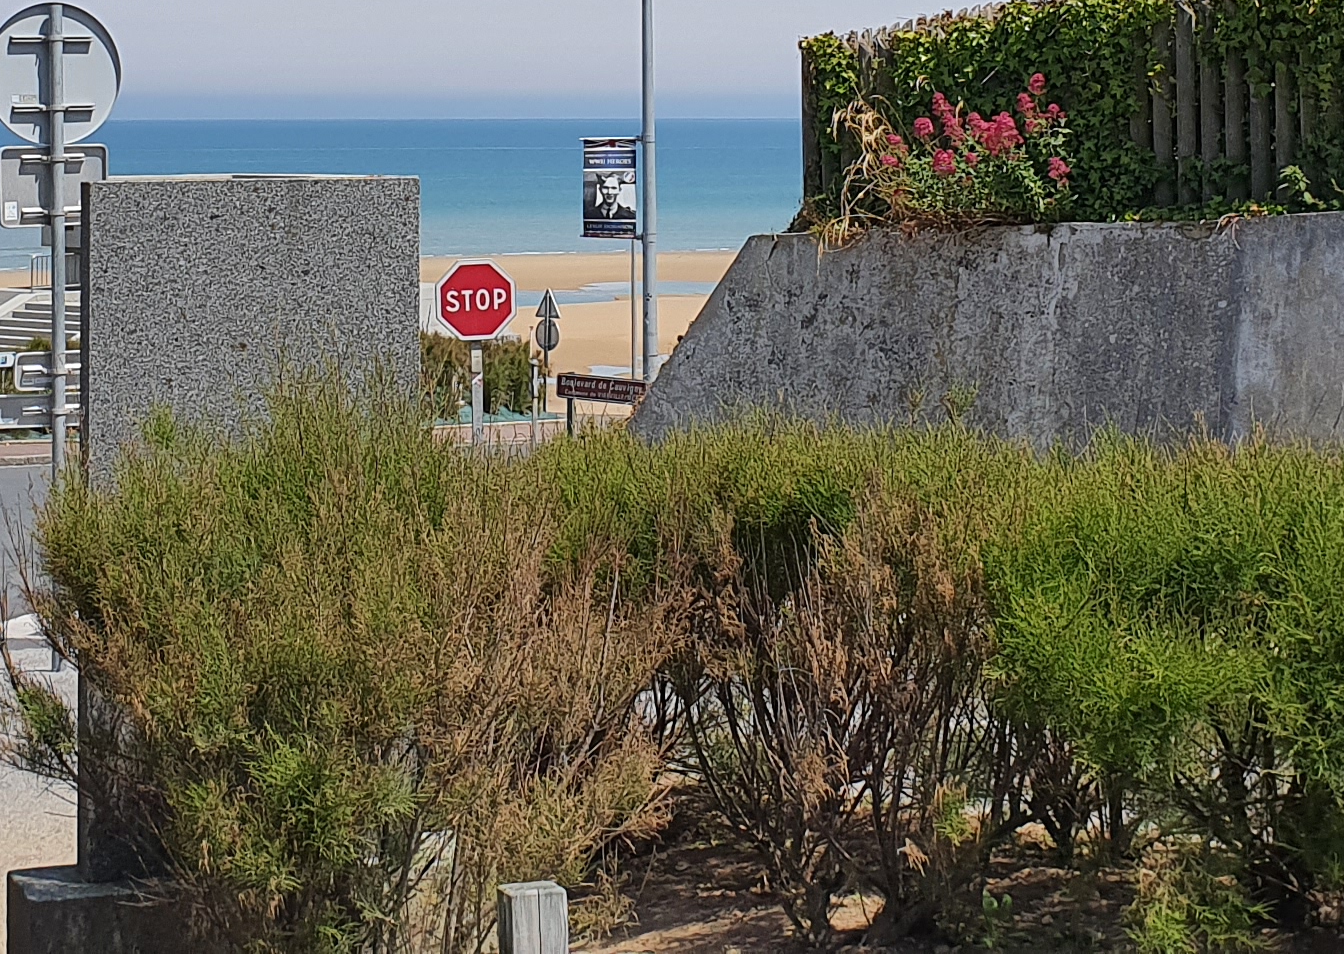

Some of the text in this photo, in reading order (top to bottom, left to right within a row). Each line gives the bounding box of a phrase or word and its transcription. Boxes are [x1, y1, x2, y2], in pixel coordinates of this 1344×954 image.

[445, 288, 507, 313] STOP
[561, 376, 643, 395] Boulevard de Cauvigny
